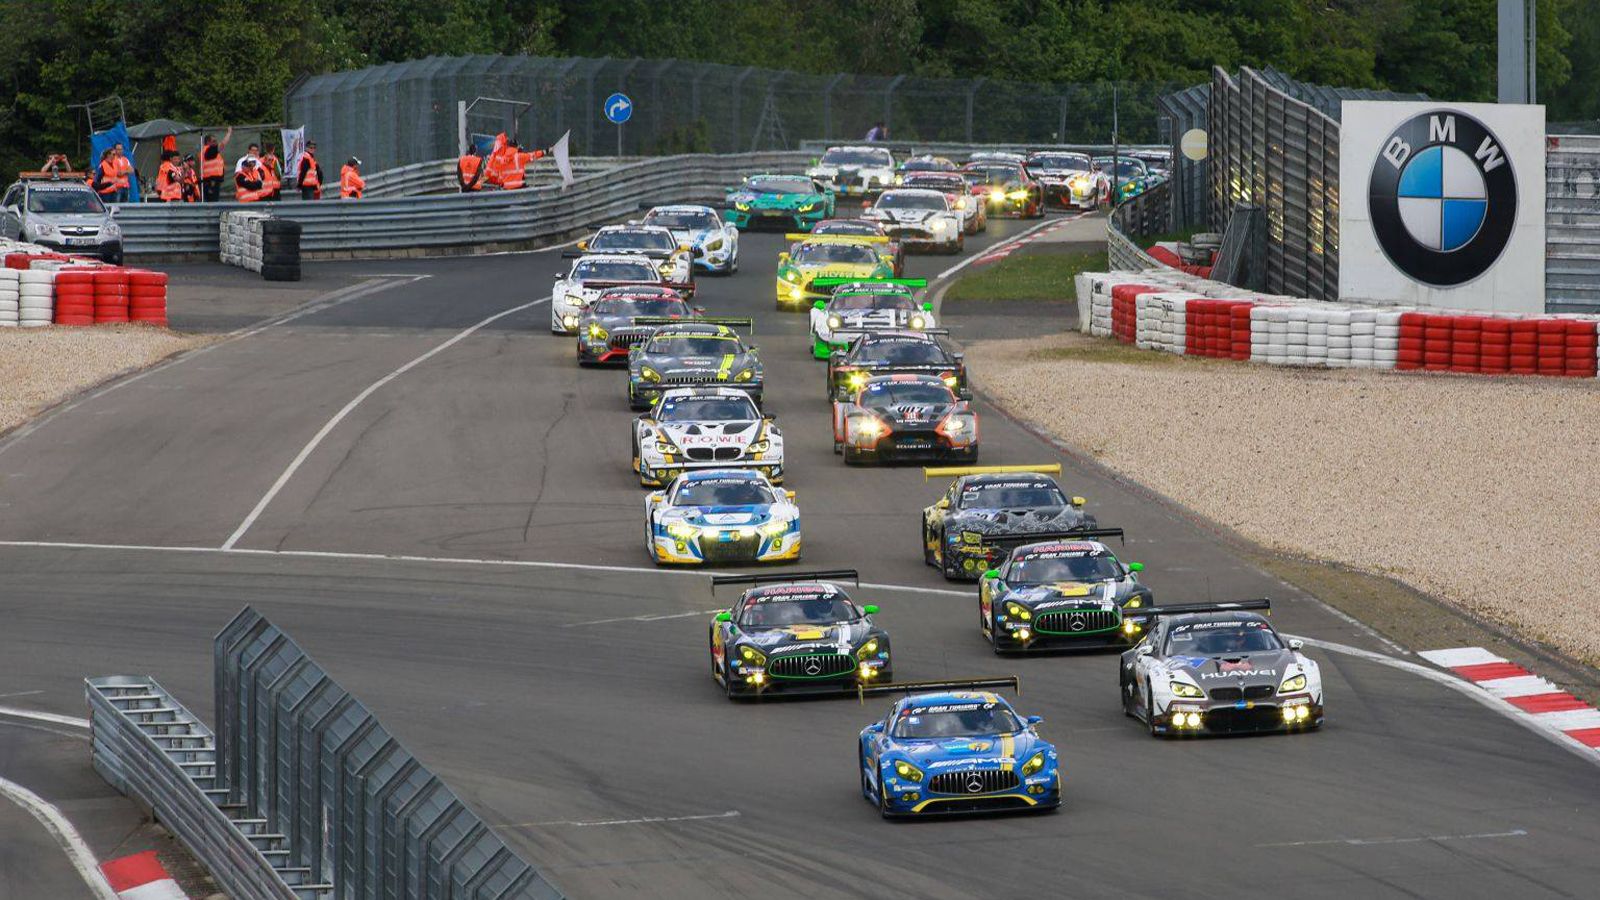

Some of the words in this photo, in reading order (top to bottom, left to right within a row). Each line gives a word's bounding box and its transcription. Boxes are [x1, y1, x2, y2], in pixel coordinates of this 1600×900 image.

[1383, 115, 1505, 173] BMW
[681, 435, 747, 444] ROWE
[1201, 669, 1276, 679] HUAWEI
[928, 705, 947, 714] GRAN
[948, 703, 981, 712] TURISMO
